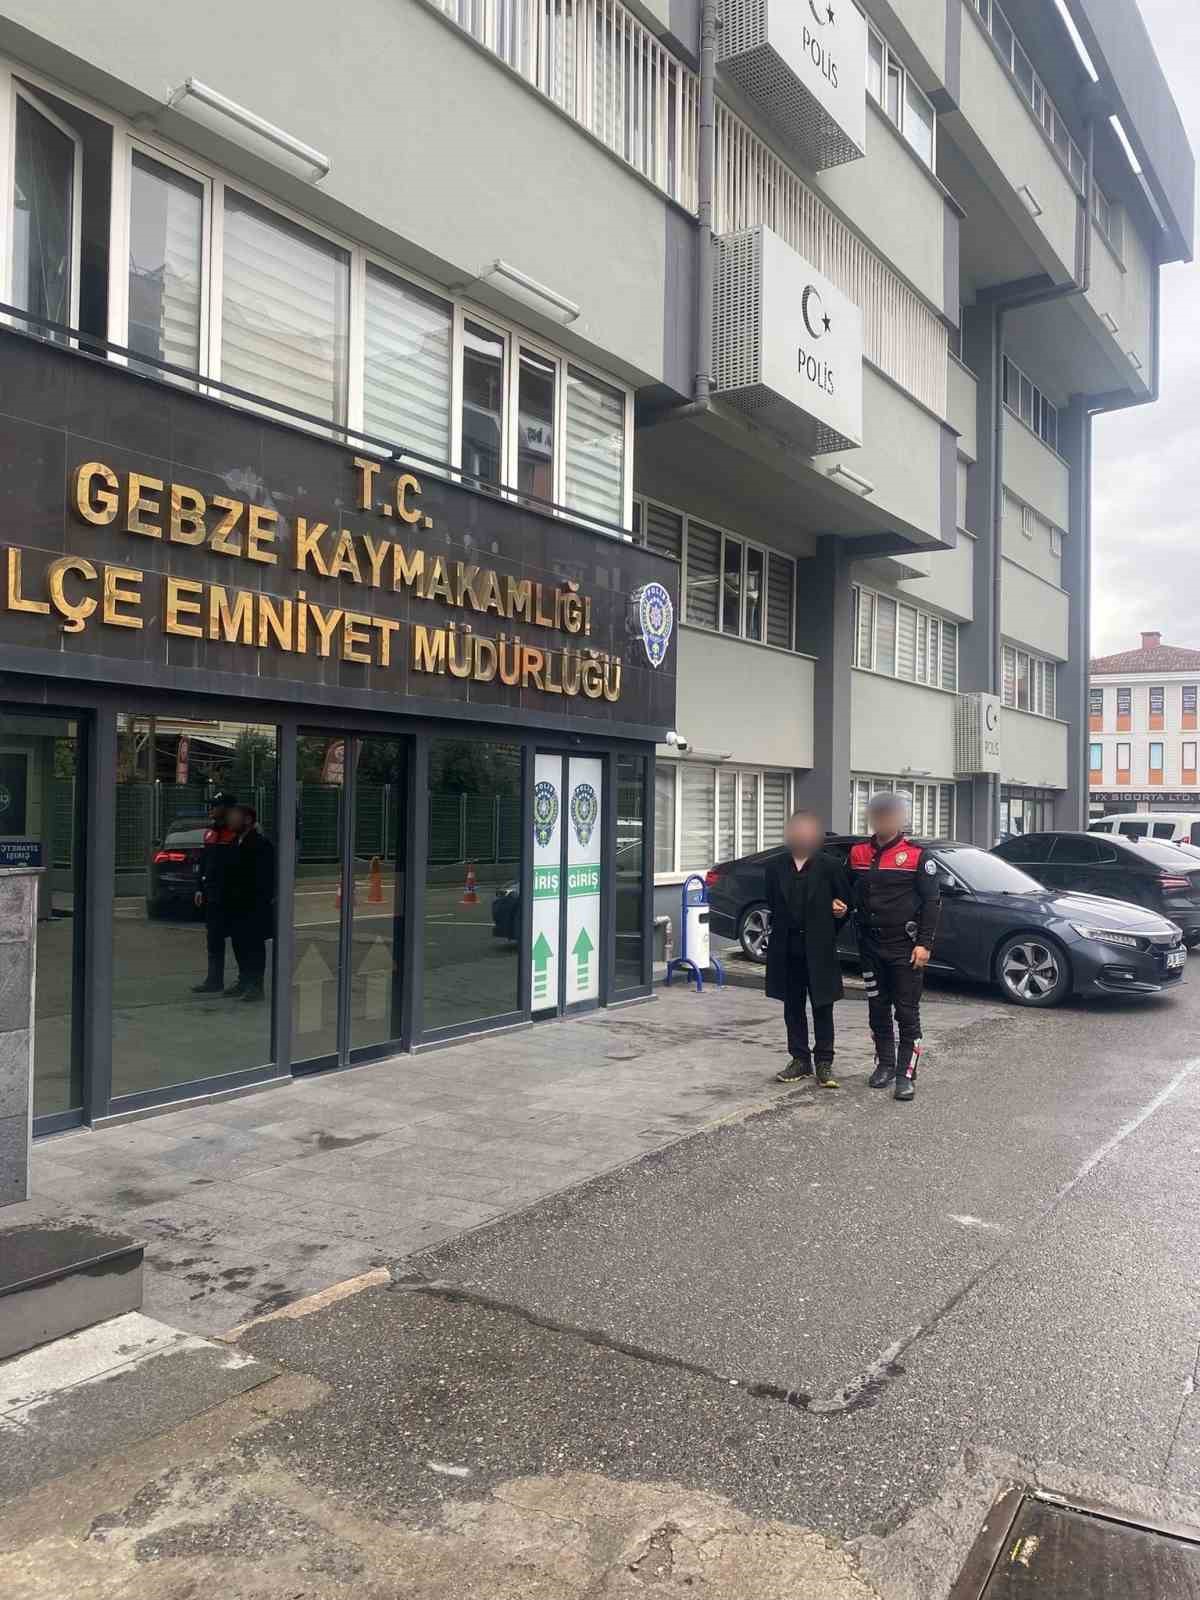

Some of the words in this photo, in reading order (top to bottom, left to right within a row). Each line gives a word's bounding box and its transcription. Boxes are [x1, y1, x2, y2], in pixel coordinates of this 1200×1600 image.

[802, 25, 839, 89] POLİS
[797, 346, 835, 396] POLİS
[352, 456, 433, 529] T.C.
[74, 461, 279, 565] GEBZE
[294, 516, 592, 637] KAYMAKAMLIĞI
[7, 546, 143, 633] LÇE
[164, 576, 400, 667] EMNİYET
[412, 619, 622, 703] MÜDÜRLÜĞÜ
[534, 870, 560, 892] İRİŞ
[568, 869, 599, 889] GİRİŞ
